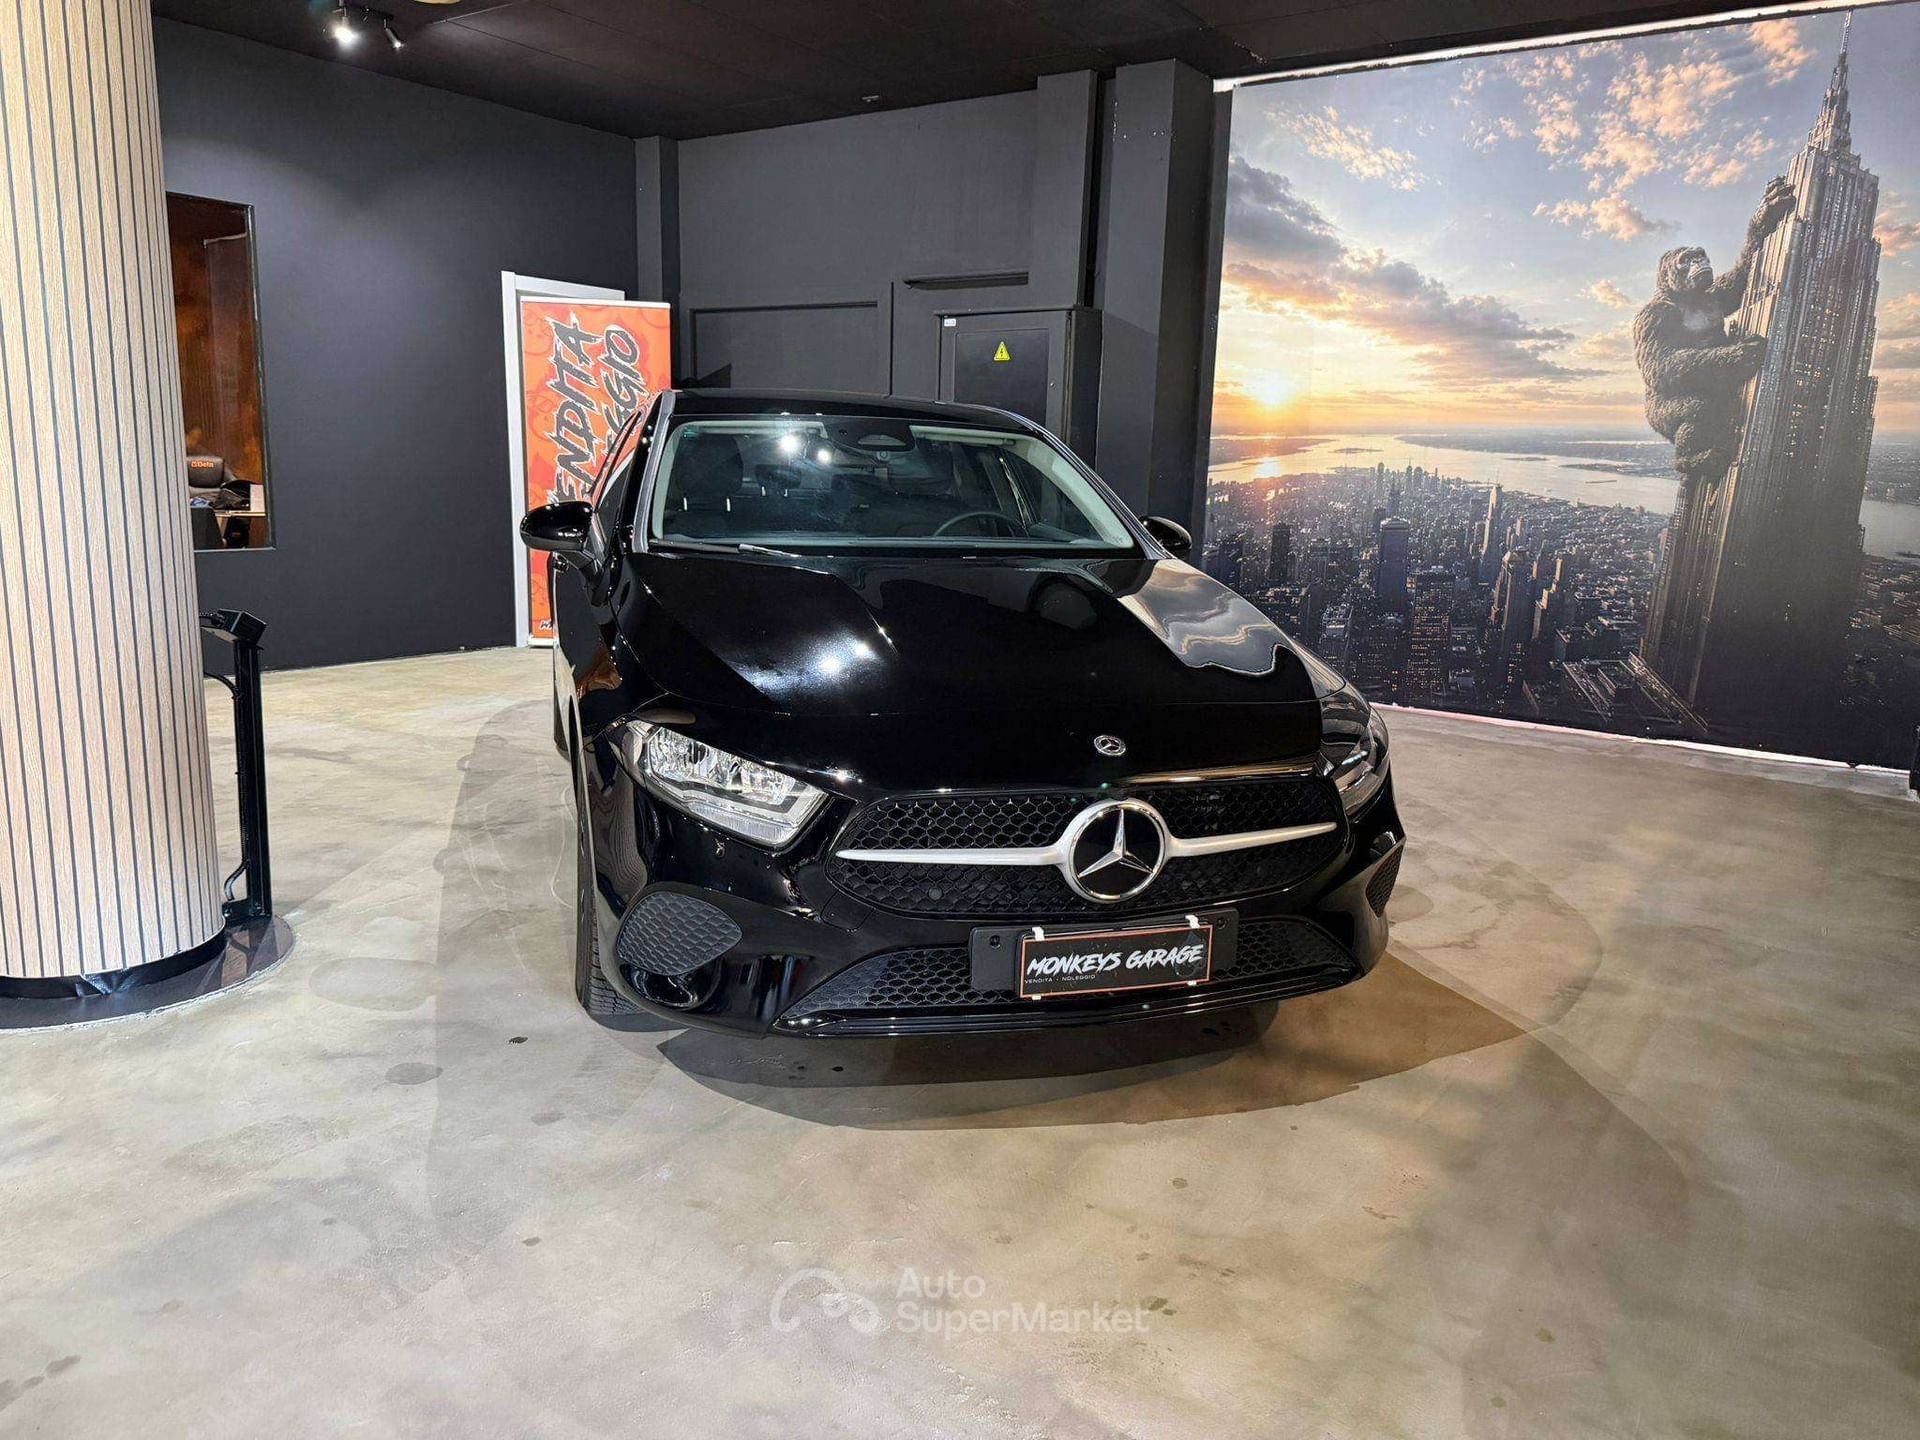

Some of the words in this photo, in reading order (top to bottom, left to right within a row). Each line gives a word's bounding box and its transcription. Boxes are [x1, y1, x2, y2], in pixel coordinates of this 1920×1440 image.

[546, 309, 603, 502] ENDITA
[1026, 951, 1123, 978] MONKEYS
[1125, 944, 1204, 971] GARAGE
[1061, 974, 1096, 982] NOLEGGIO
